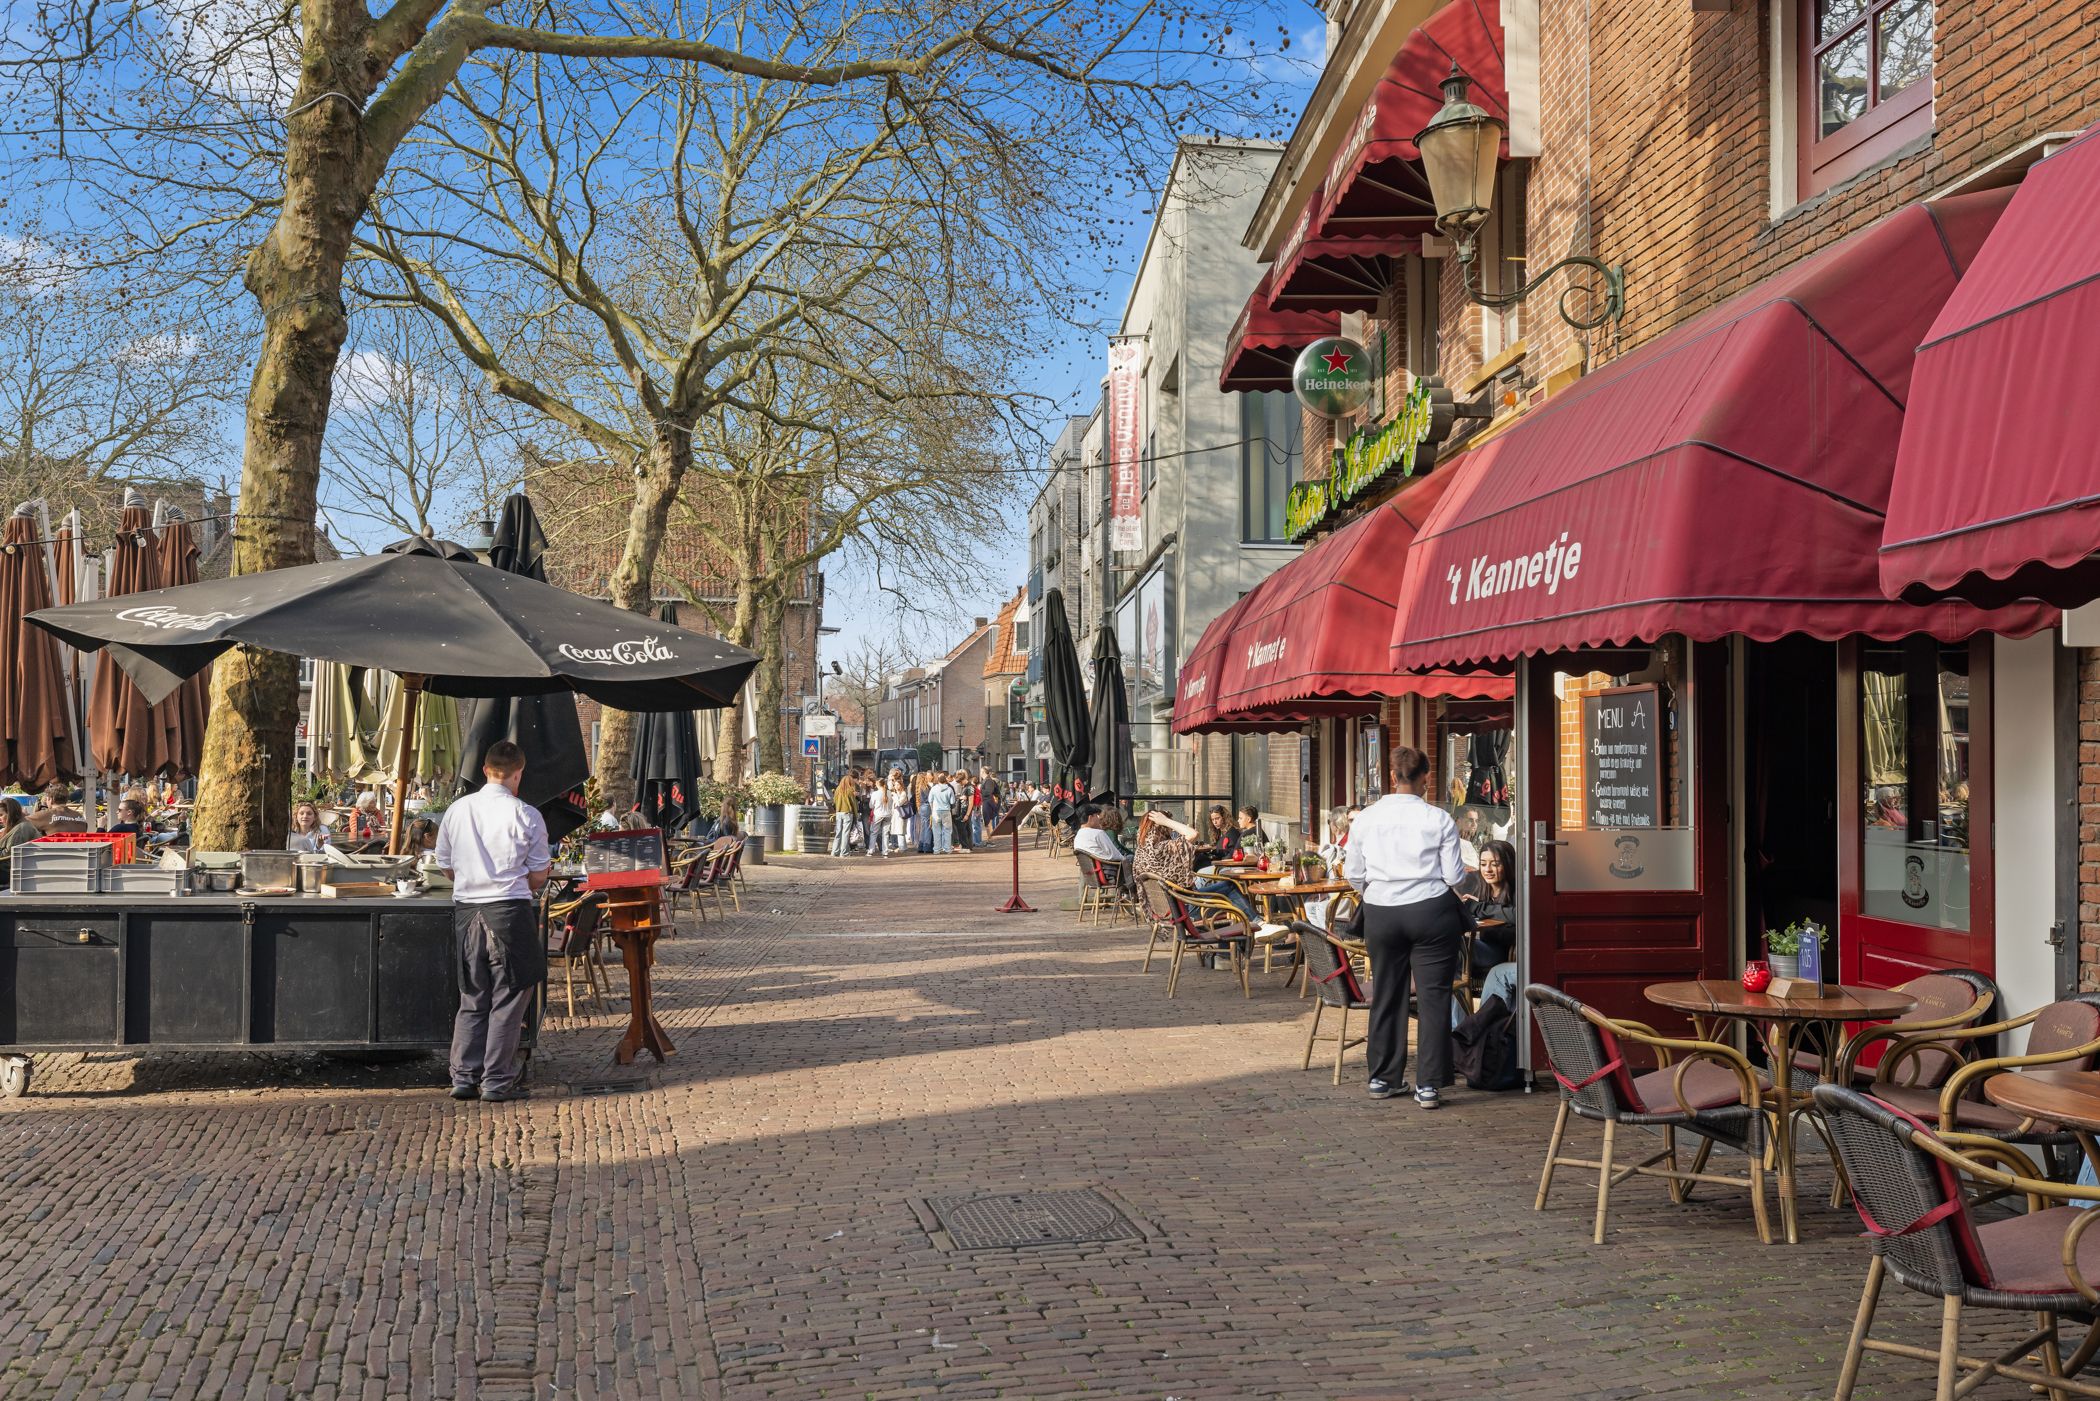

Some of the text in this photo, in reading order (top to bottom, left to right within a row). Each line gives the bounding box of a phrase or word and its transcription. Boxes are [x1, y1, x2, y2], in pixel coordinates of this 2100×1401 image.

[1304, 378, 1369, 391] Heineken
[1117, 379, 1134, 441] Vrouw
[1116, 447, 1134, 497] Lieve
[1465, 531, 1582, 602] Kannetje
[559, 637, 674, 665] Coca-Cola
[1252, 636, 1287, 668] Kannete
[1597, 700, 1645, 730] MENU A
[1669, 711, 1675, 730] 9
